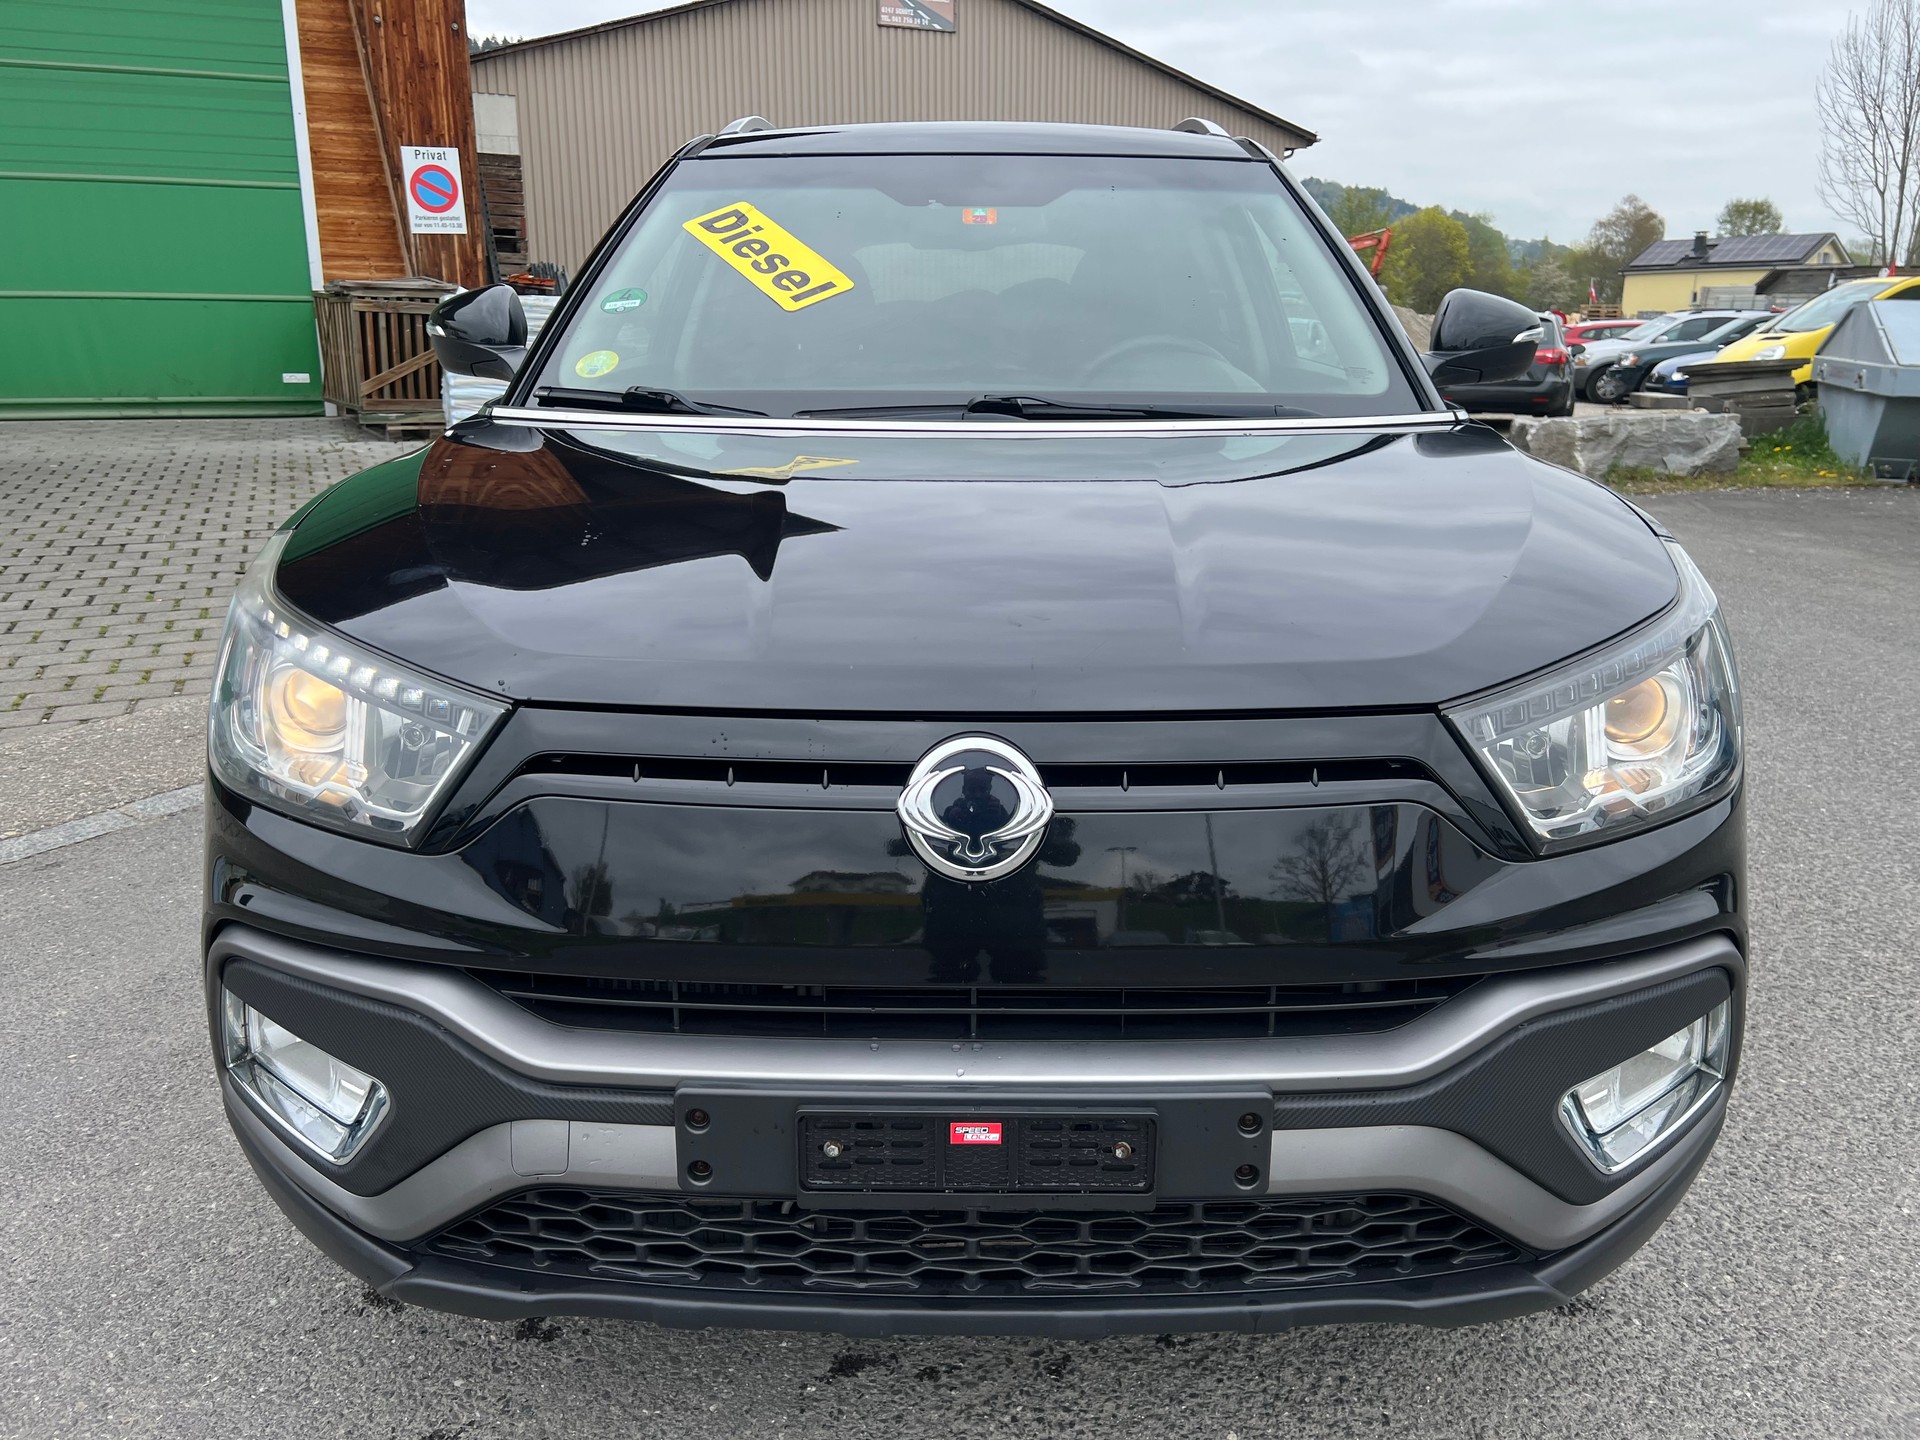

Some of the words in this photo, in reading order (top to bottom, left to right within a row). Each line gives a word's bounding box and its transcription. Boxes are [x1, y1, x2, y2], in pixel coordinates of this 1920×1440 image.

[414, 149, 447, 160] Privat
[698, 209, 838, 303] Diesel
[955, 1126, 989, 1134] SPEED
